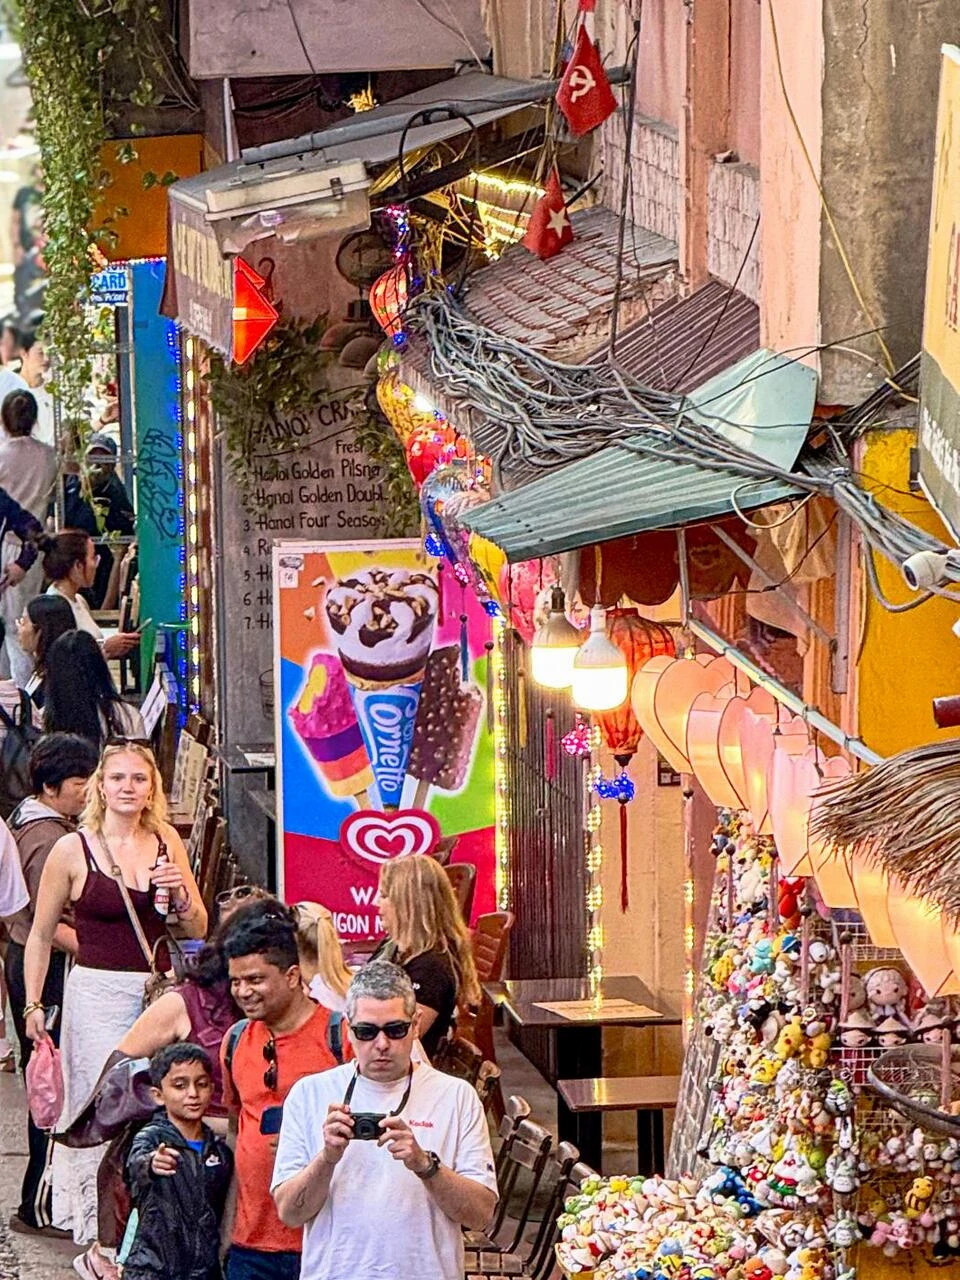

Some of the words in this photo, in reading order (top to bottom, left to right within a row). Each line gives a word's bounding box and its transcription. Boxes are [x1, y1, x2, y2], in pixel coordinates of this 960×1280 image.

[291, 459, 334, 481] Golden
[341, 458, 382, 480] Pilsner
[298, 485, 343, 504] Golden
[346, 483, 385, 503] Doubl
[299, 512, 330, 529] Four
[353, 687, 420, 793] Cornetto
[332, 911, 370, 935] IGON
[408, 1119, 434, 1129] Kodak
